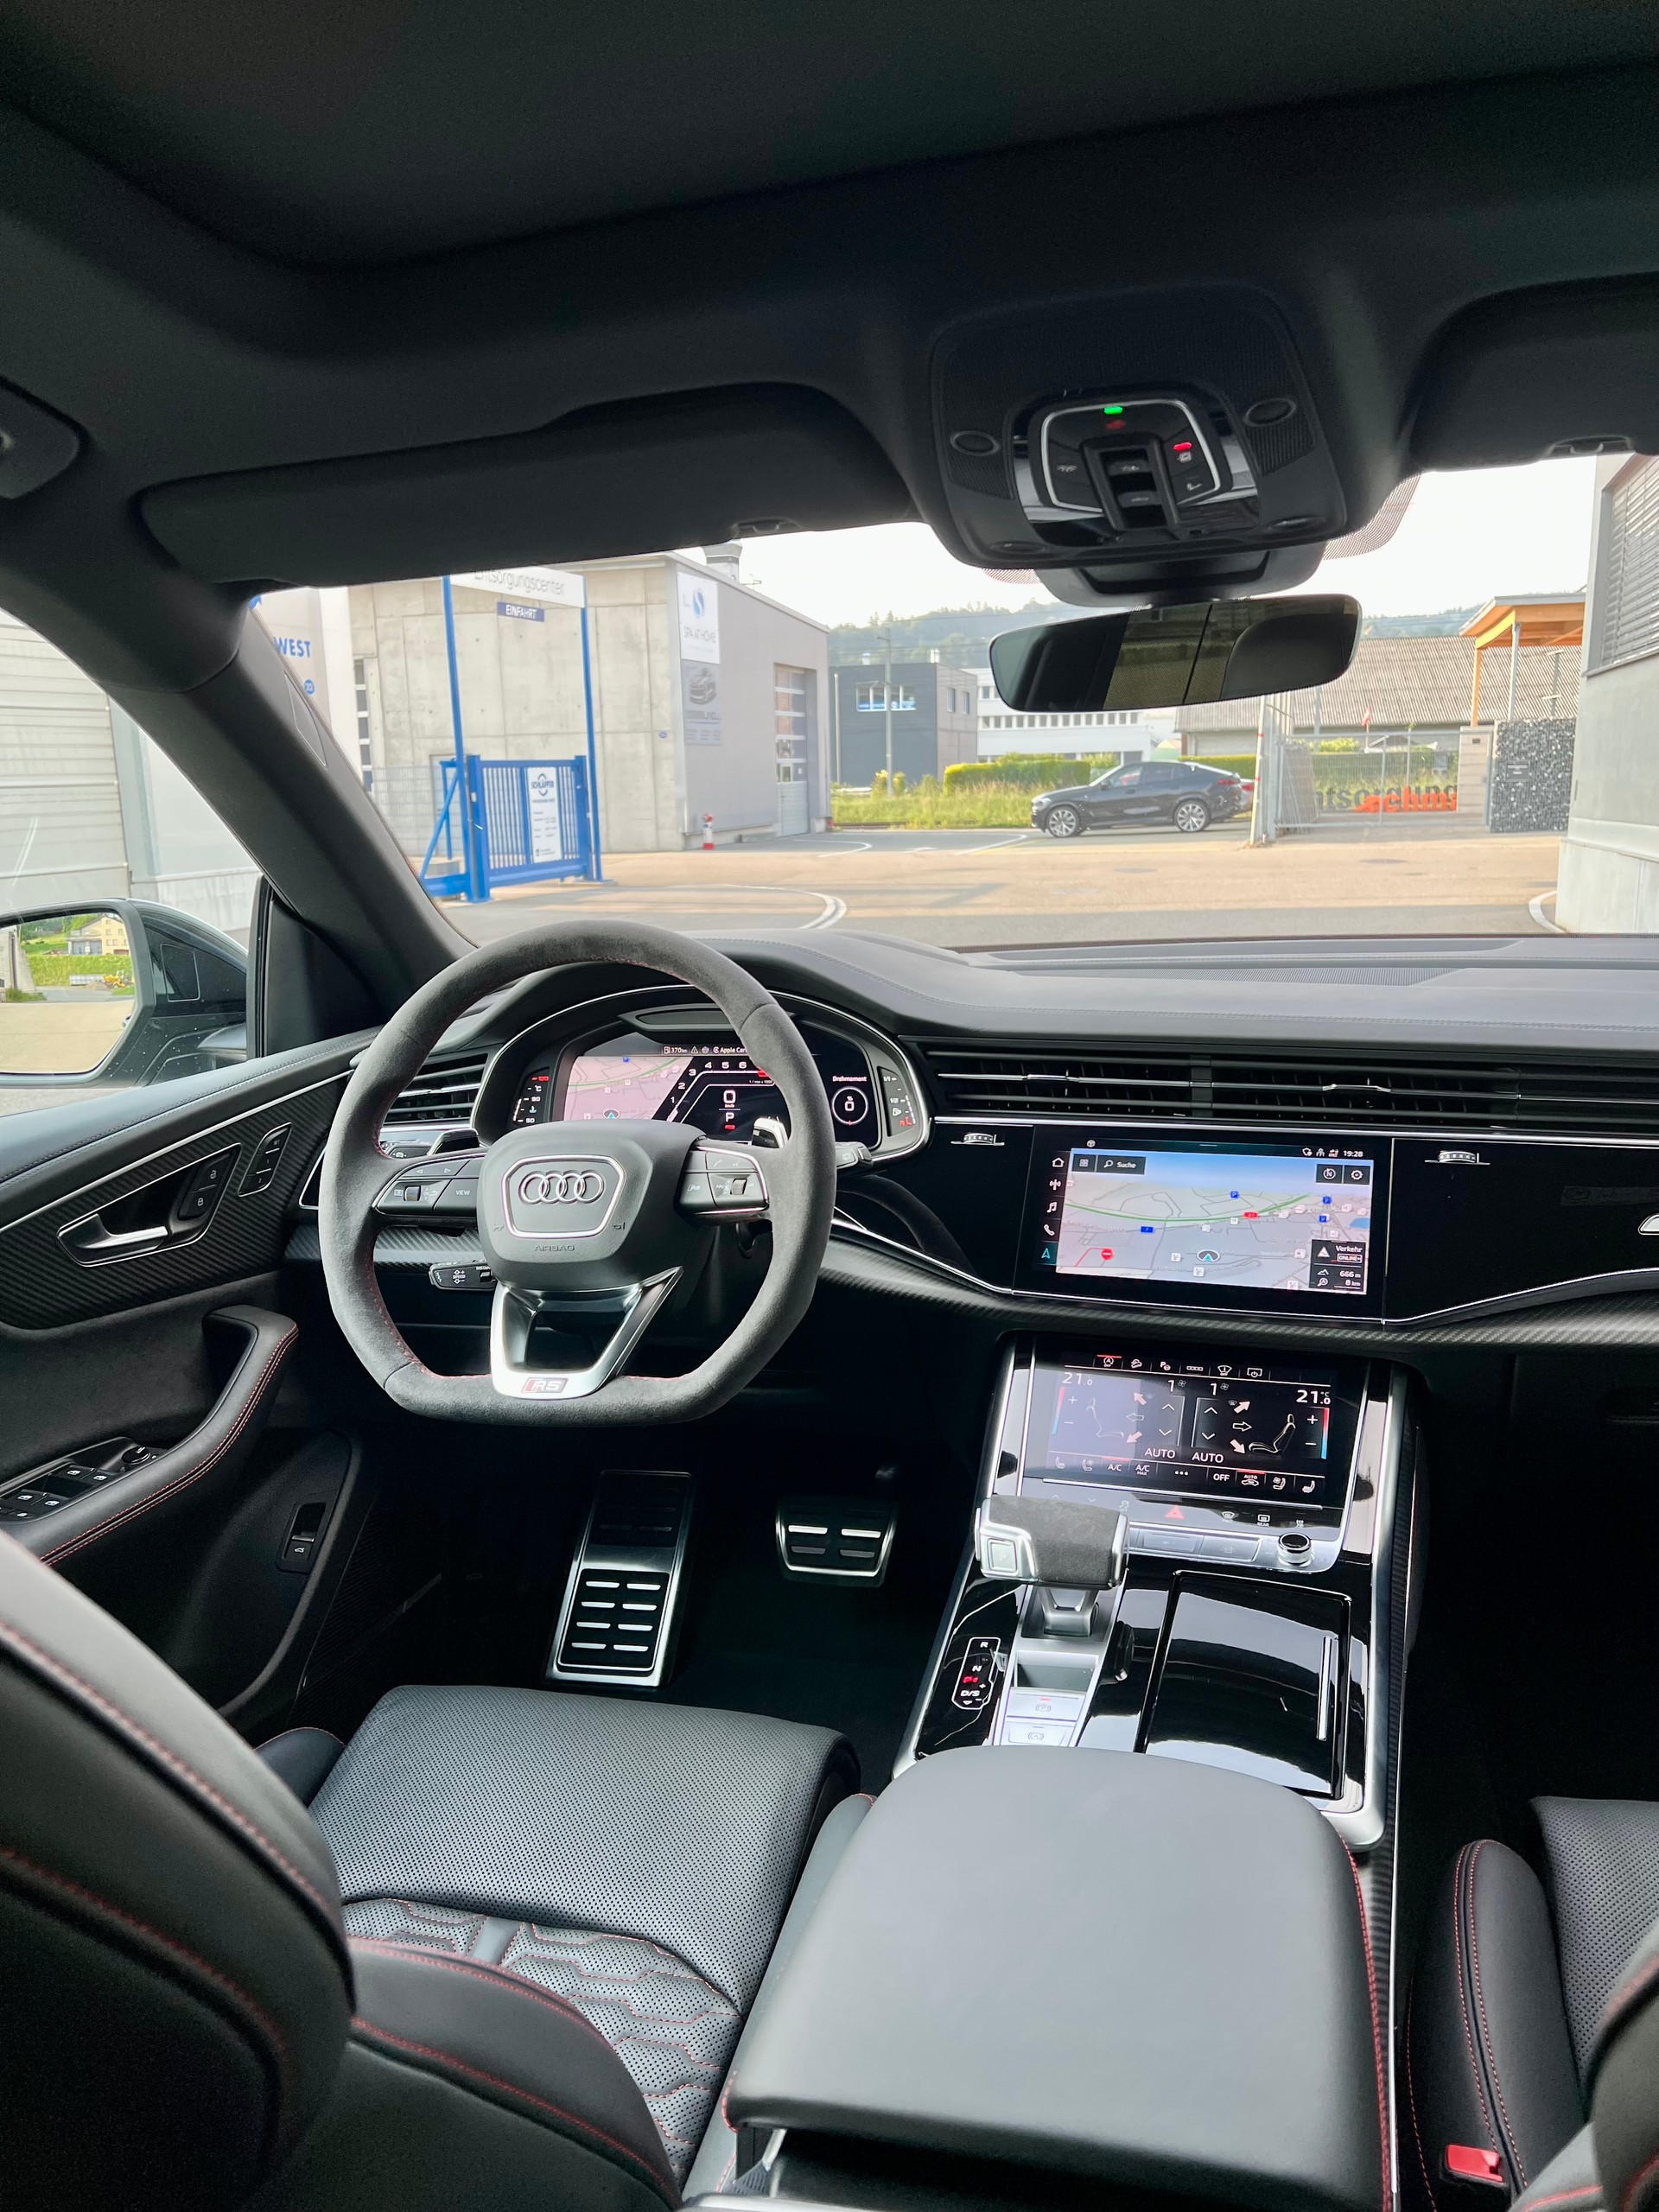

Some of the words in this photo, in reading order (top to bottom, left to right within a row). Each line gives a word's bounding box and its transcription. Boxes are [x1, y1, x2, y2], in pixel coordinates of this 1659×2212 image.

[505, 604, 537, 619] EINFAHRT
[272, 636, 311, 658] WEST
[720, 1046, 735, 1055] Apple
[723, 1090, 736, 1104] 0
[844, 1101, 855, 1111] 0
[726, 1112, 734, 1122] P
[1167, 1379, 1175, 1393] 1
[1210, 1382, 1217, 1396] 1
[1144, 1447, 1176, 1459] AUTO
[1192, 1452, 1224, 1464] AUTO
[1107, 1463, 1122, 1471] A/C
[1135, 1464, 1151, 1472] A/C
[1212, 1473, 1230, 1482] OFF
